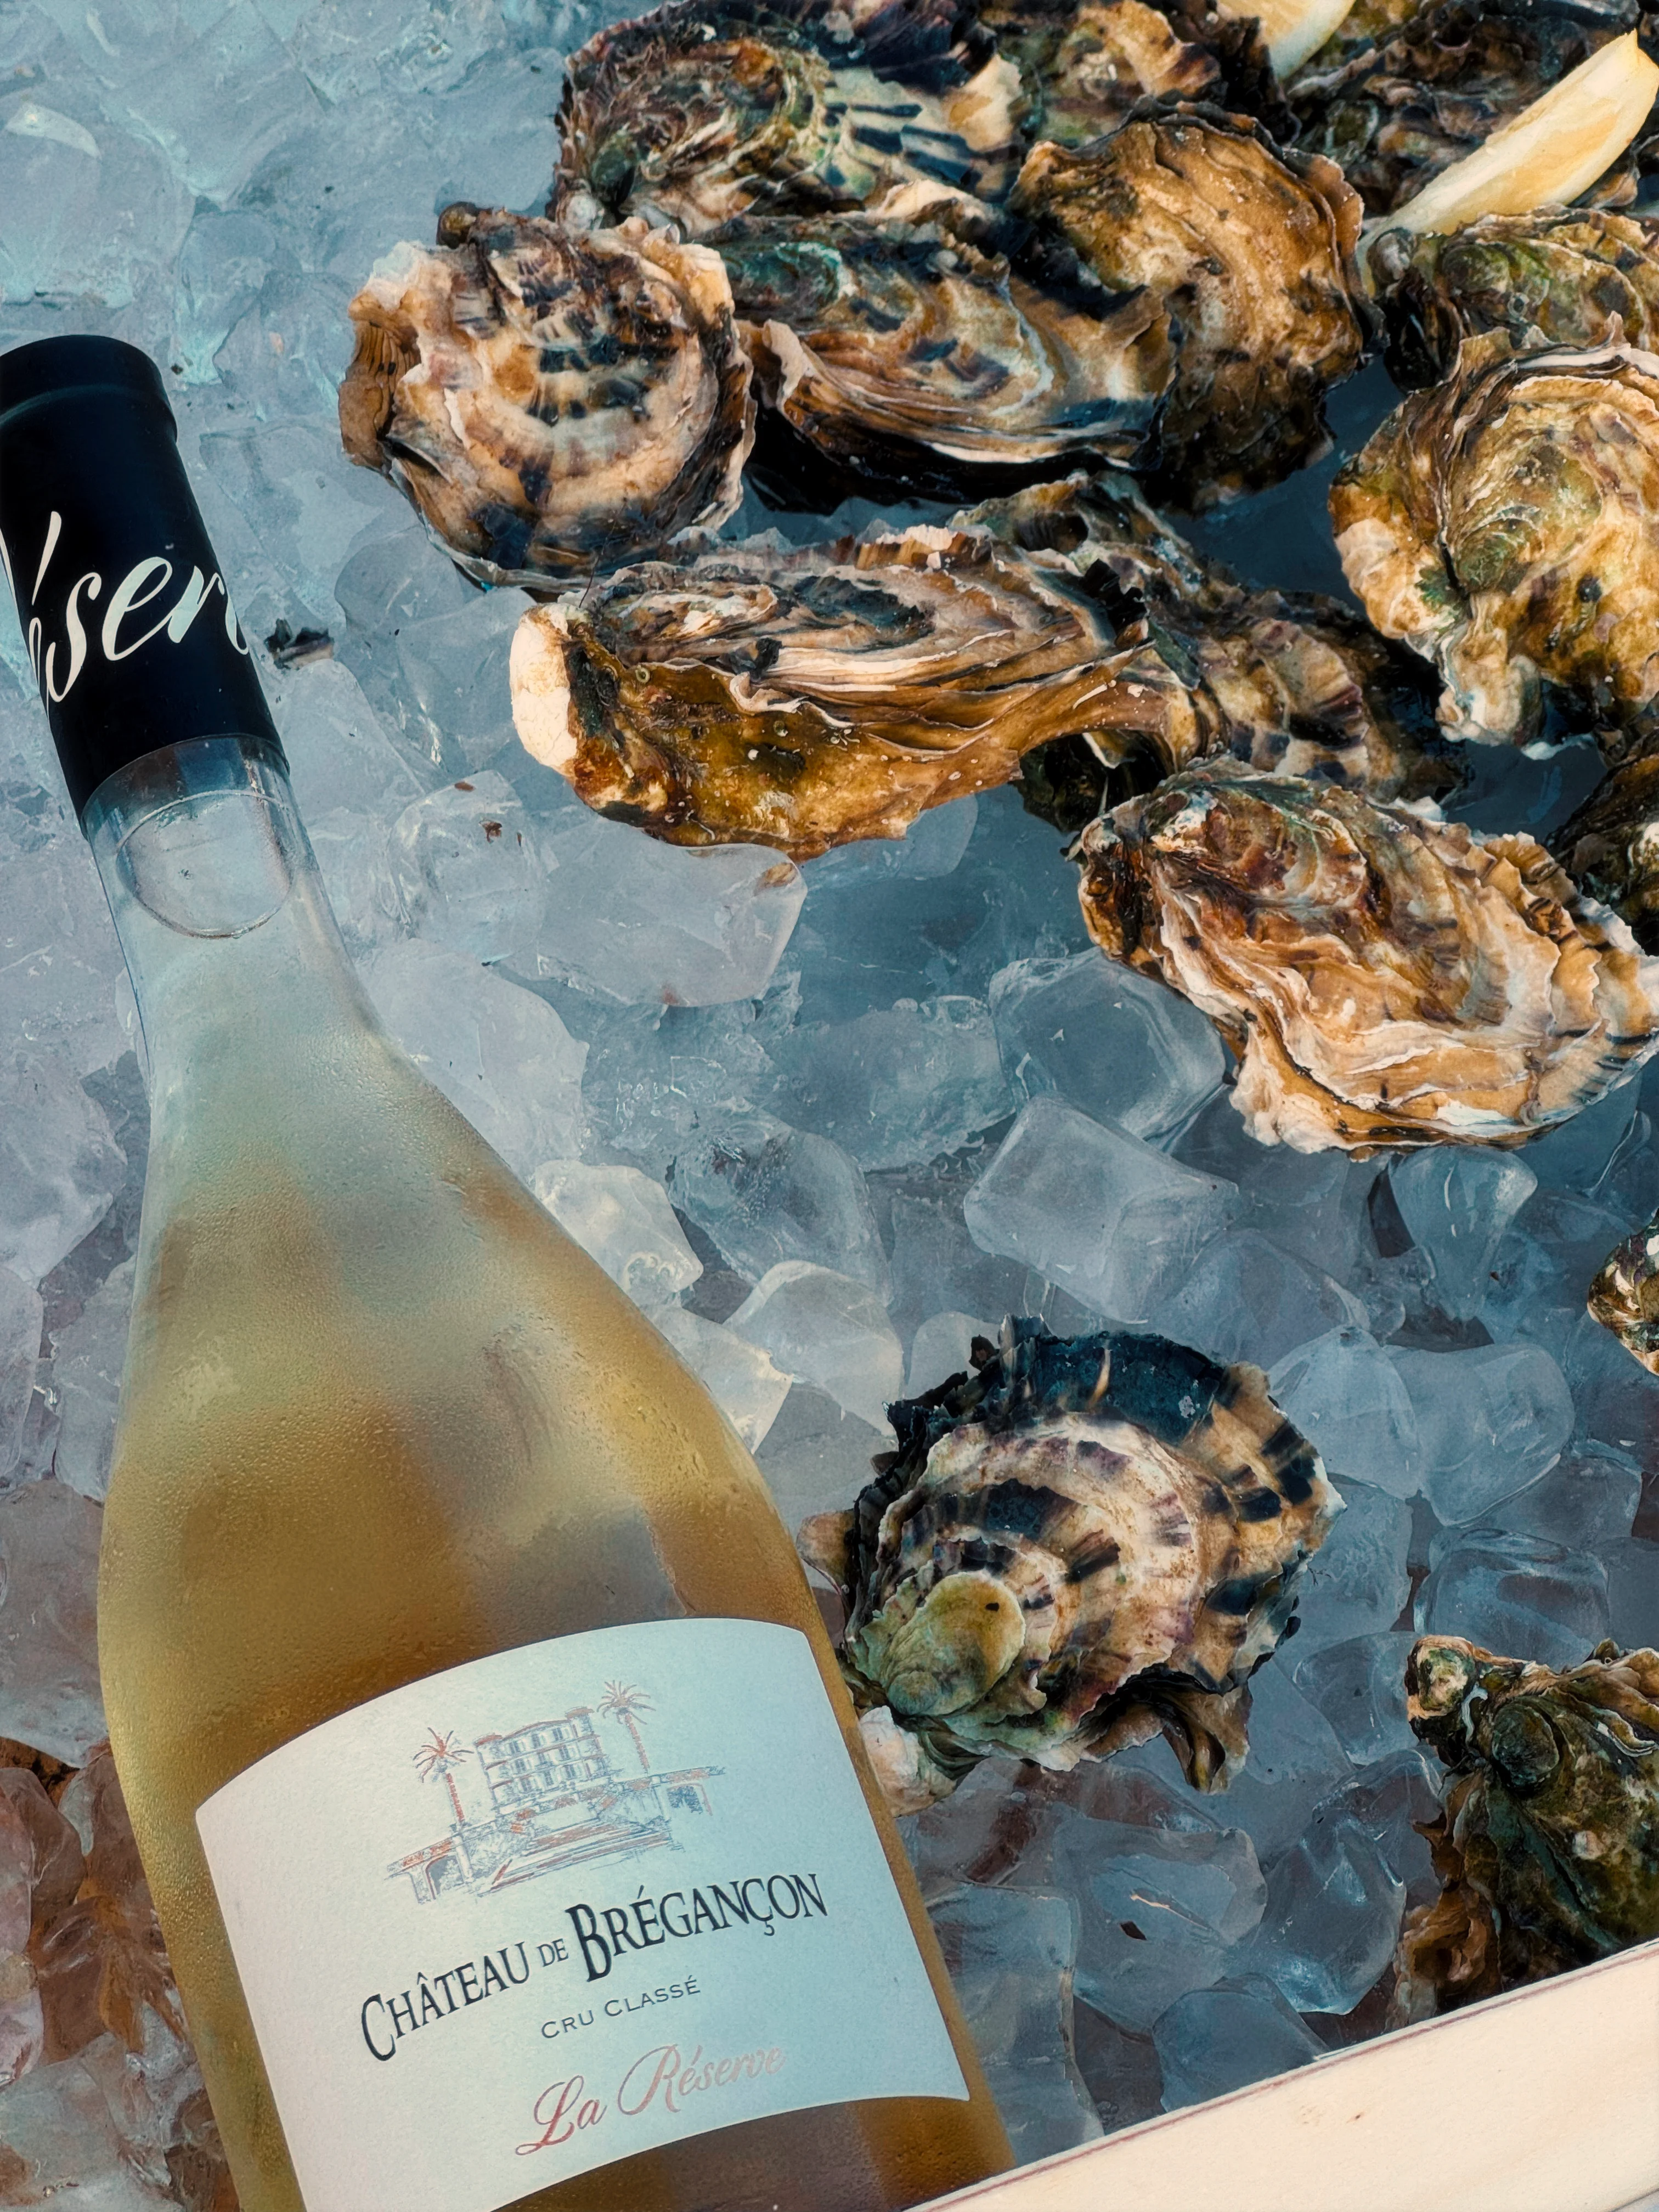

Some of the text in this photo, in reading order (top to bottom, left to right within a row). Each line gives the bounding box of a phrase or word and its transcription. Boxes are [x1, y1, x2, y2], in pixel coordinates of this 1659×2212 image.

[360, 1873, 829, 2062] CHÂTEAU DE BRÉGANÇON
[541, 1975, 701, 2039] CRU CLASSÉ
[515, 2043, 787, 2156] La Réserve
